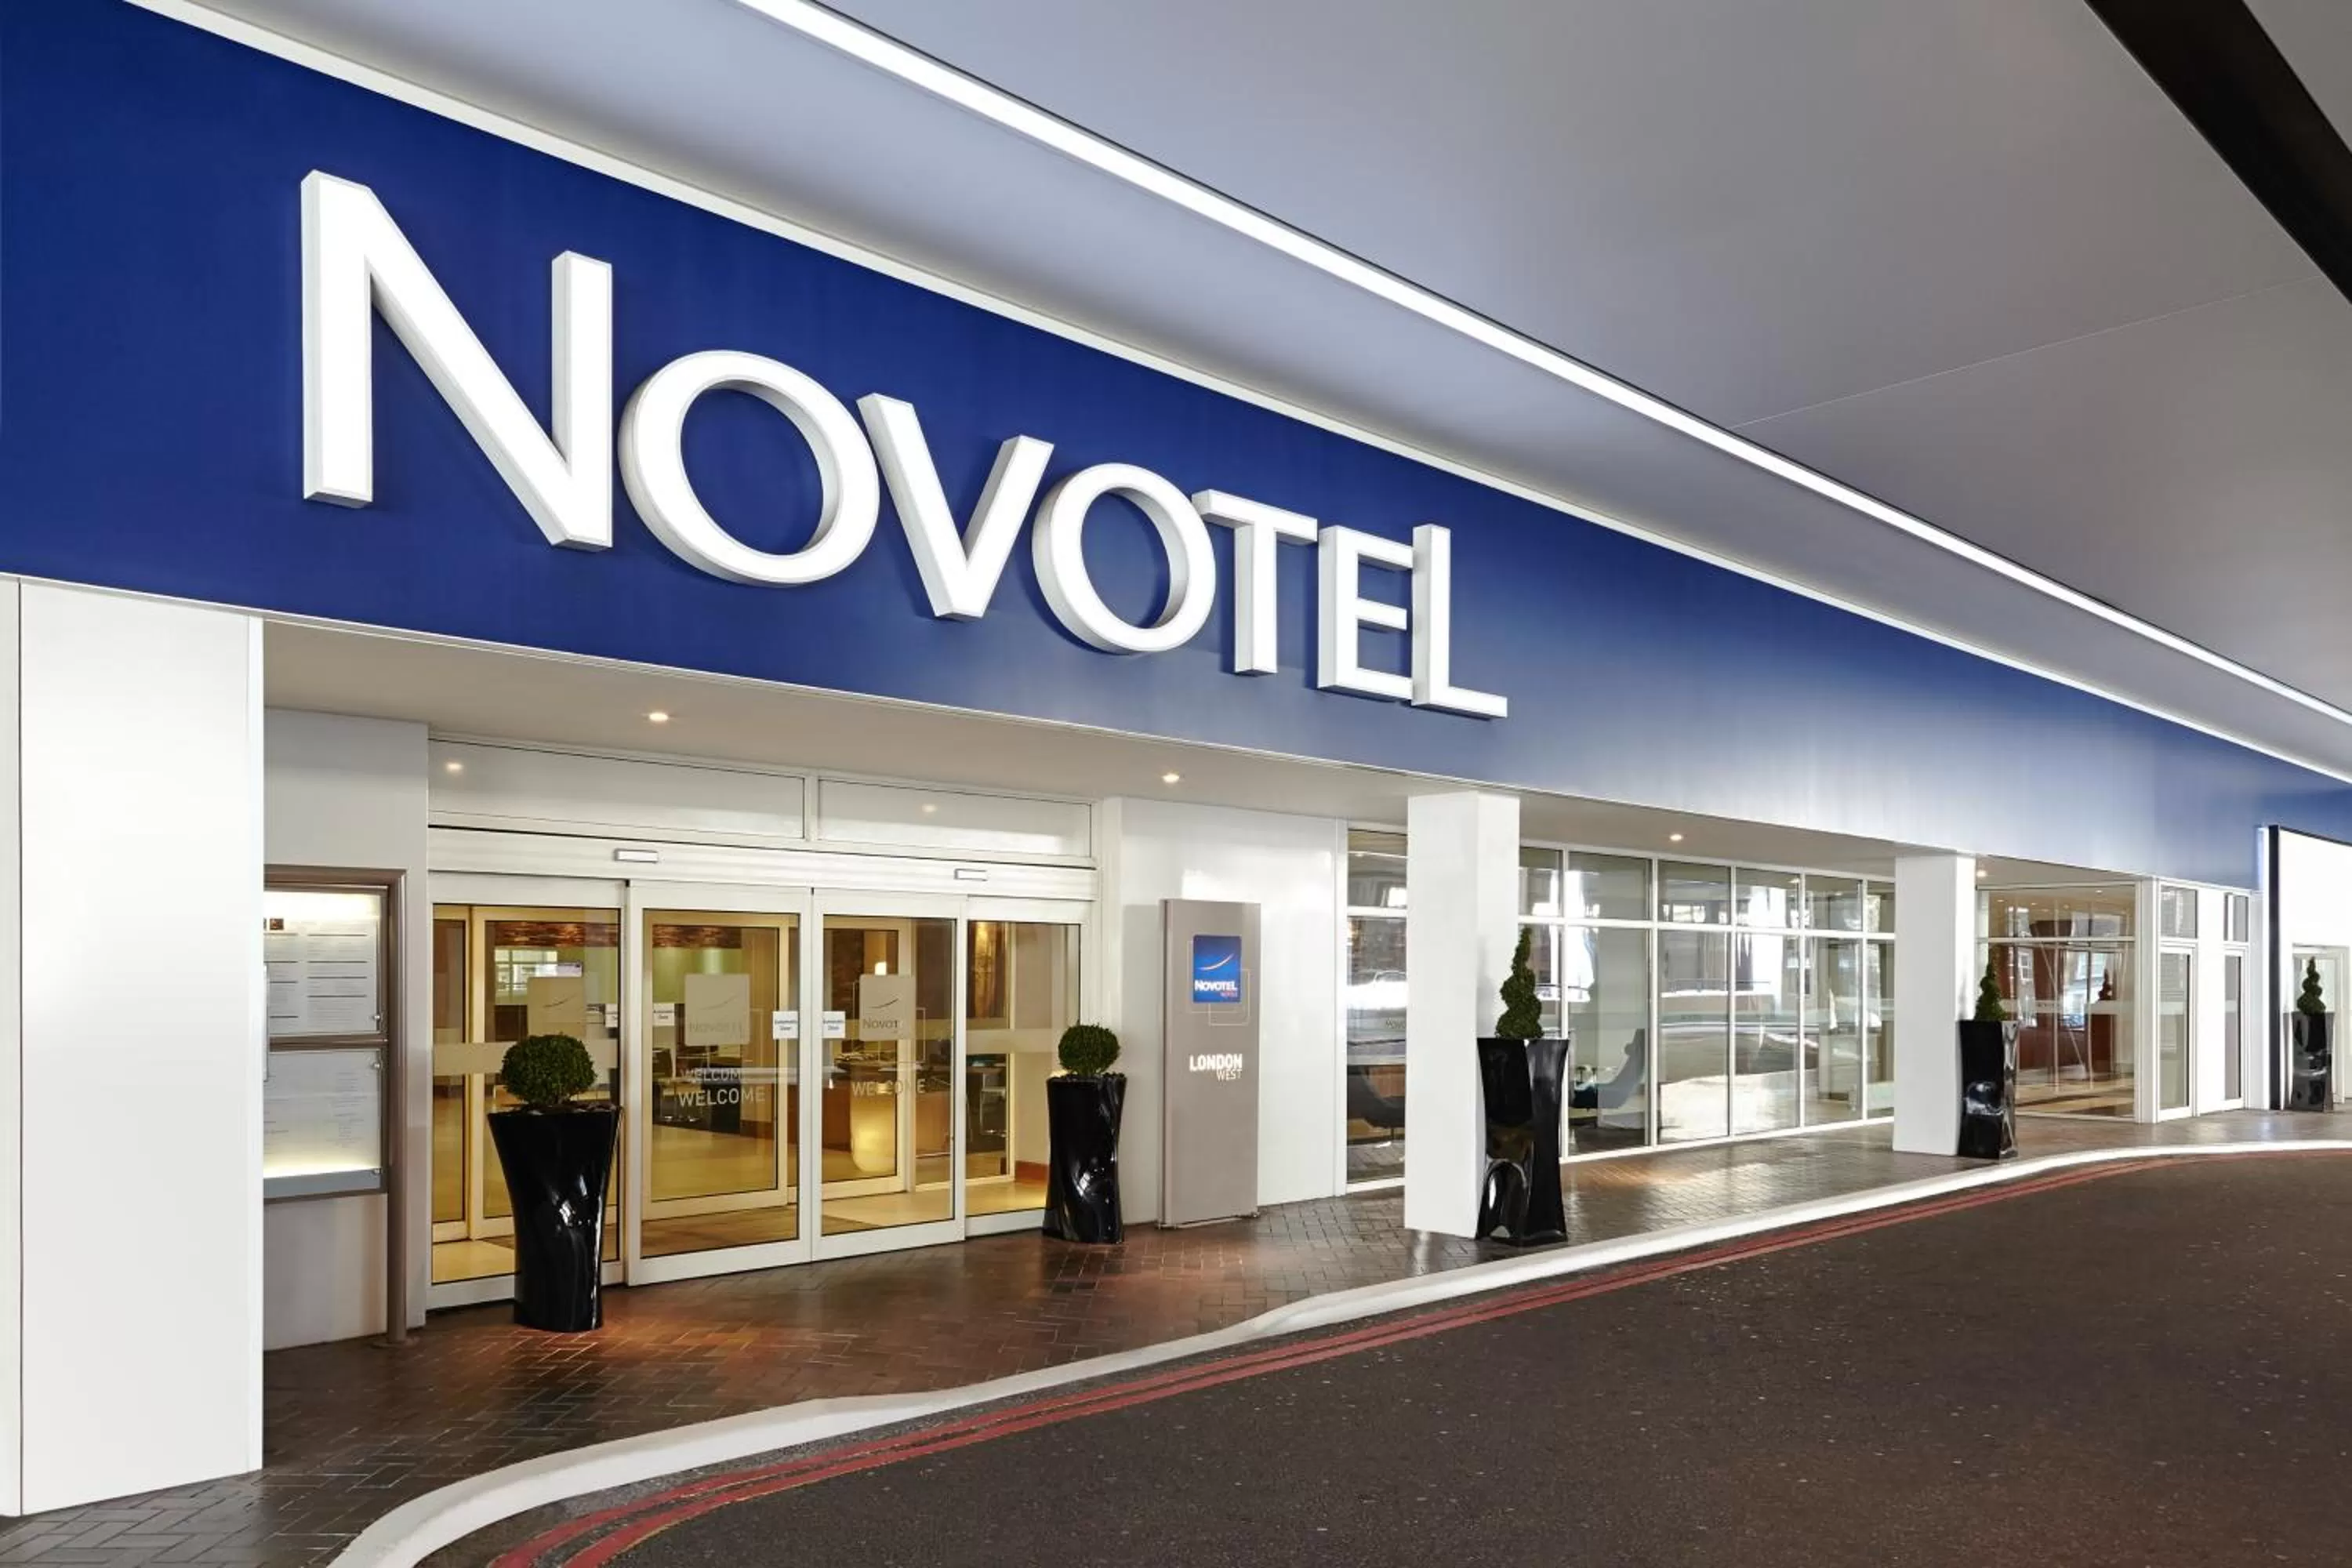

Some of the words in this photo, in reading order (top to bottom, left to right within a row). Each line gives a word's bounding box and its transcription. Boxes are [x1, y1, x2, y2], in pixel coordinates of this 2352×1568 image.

[301, 169, 1508, 718] NOVOTEL
[1194, 979, 1238, 991] NOVOTEL
[1189, 1053, 1243, 1072] LONDON
[1216, 1069, 1243, 1081] WEST
[678, 1085, 766, 1107] WELCOME
